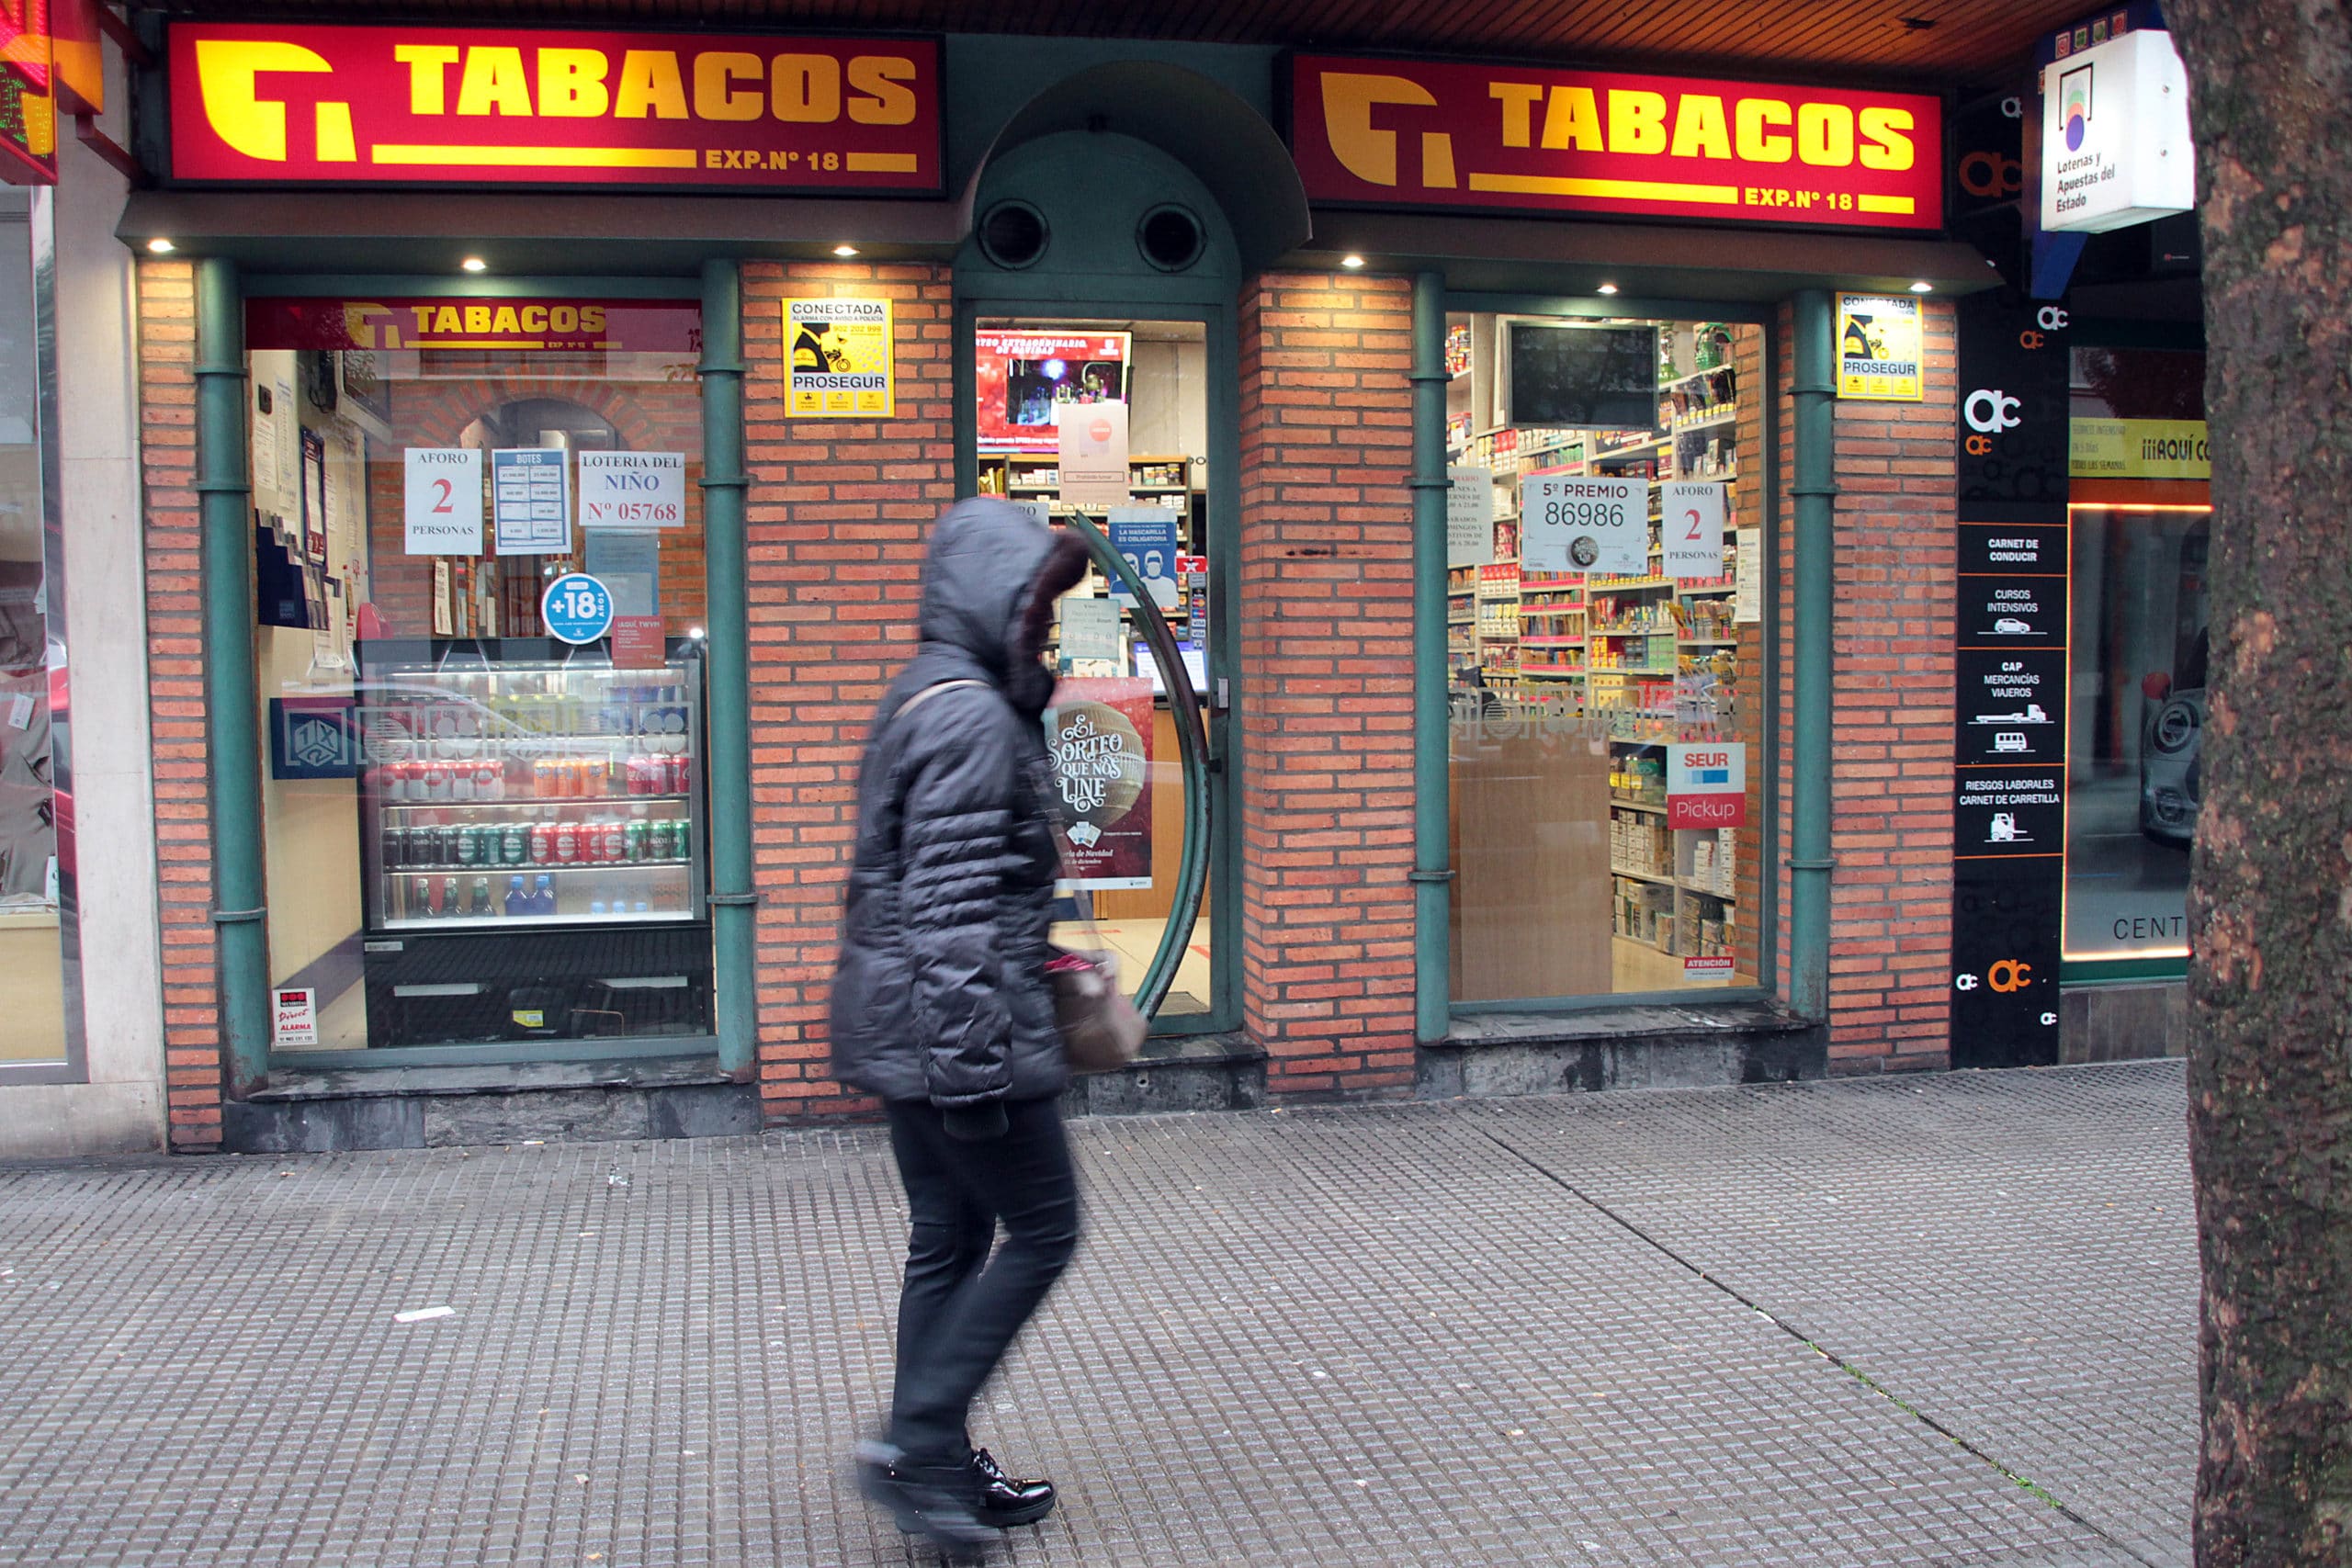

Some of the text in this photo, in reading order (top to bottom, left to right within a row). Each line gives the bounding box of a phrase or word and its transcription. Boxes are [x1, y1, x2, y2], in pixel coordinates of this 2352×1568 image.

[395, 44, 917, 125] TABACOS
[1488, 81, 1915, 171] TABACOS
[808, 151, 840, 171] 18
[2095, 152, 2101, 167] y
[2056, 164, 2116, 194] Apuestas del
[1826, 193, 1853, 211] 18
[2056, 193, 2086, 213] Estado
[792, 303, 883, 315] CONECTADA
[412, 305, 605, 334] TABACOS
[1844, 362, 1917, 375] PROSEGUR
[793, 376, 886, 388] PROSEGUR
[417, 453, 469, 465] AFORO
[516, 454, 542, 464] BOTES
[582, 455, 682, 469] LOTERIA DEL
[605, 471, 660, 491] NIÑO
[432, 479, 454, 513] 2
[1565, 484, 1629, 499] PREMIO
[1672, 485, 1713, 497] AFORO
[618, 502, 677, 521] 05768
[1545, 502, 1624, 527] 86986
[413, 525, 474, 536] PERSONAS
[1684, 509, 1702, 540] 2
[1988, 538, 2040, 549] CARNET DE
[1669, 550, 1718, 560] PERSONAS
[1989, 551, 2038, 562] CONDUCIR
[1995, 589, 2031, 600] CURSOS
[1987, 602, 2039, 613] INTENSIVOS
[2001, 661, 2023, 671] CAP
[1984, 673, 2041, 685] MERCANCÍAS
[1991, 687, 2032, 698] VIAJEROS
[1047, 733, 1123, 772] SORTEO
[1061, 754, 1123, 780] QUE NOS
[1684, 752, 1728, 768] SEUR
[1965, 779, 2055, 791] RIESGOS LABORALES
[1055, 777, 1107, 813] UNE
[1960, 794, 2061, 806] CARNET DE CARRETILLA
[1676, 800, 1736, 819] Pickup
[1085, 849, 1114, 857] Navidad
[2113, 916, 2184, 940] CENT
[1687, 958, 1731, 967] ATENCIÓN
